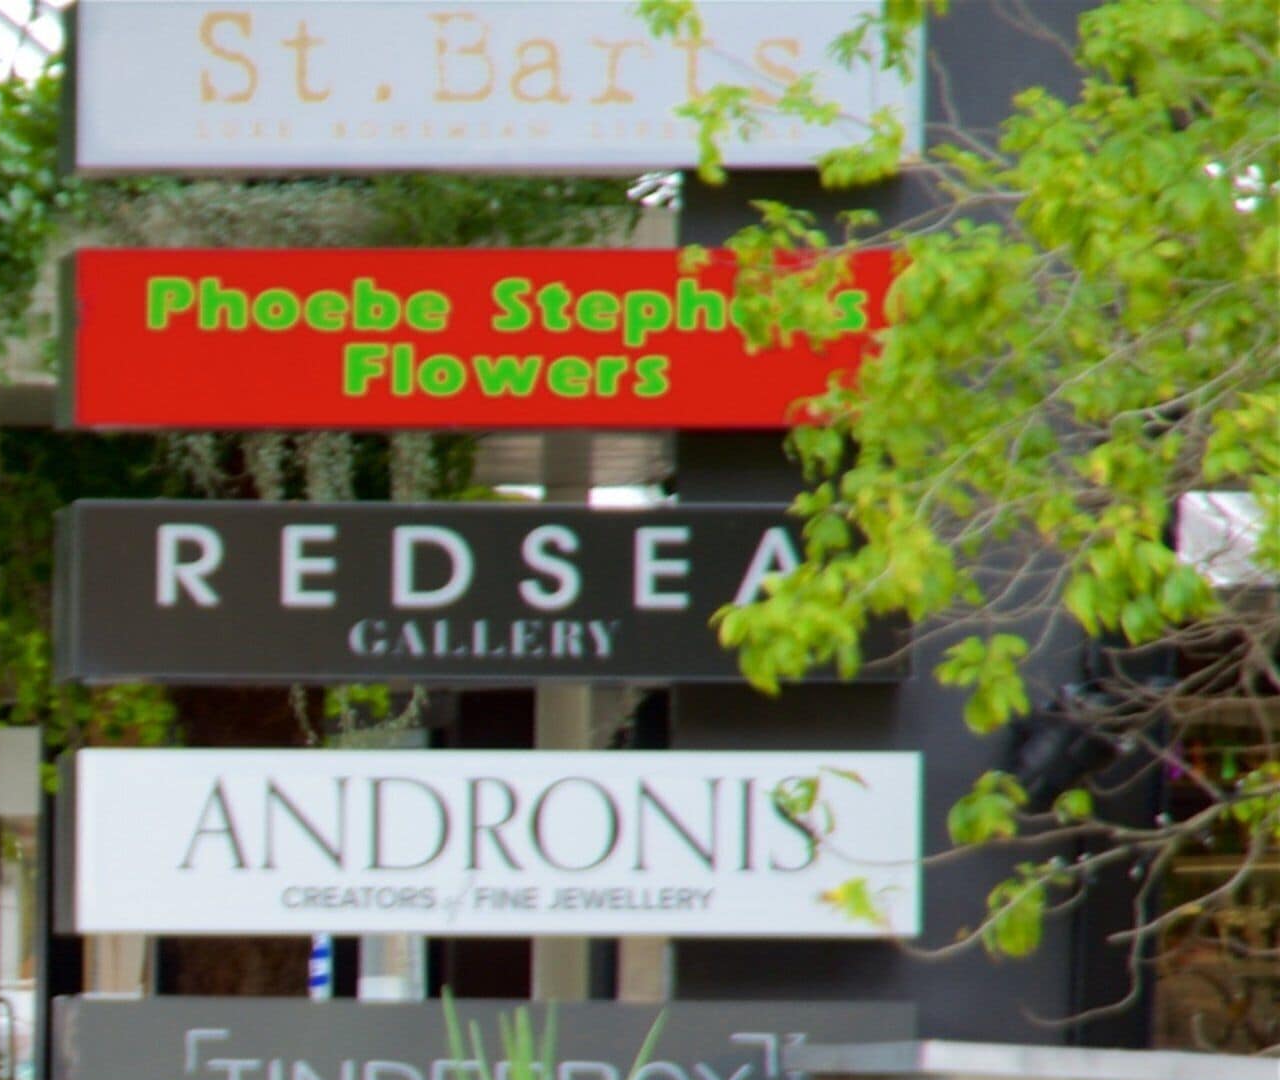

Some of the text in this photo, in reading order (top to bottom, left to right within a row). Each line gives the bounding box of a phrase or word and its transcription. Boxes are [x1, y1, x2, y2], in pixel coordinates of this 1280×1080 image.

[146, 276, 869, 346] Phoebe Stephs
[342, 342, 669, 398] Flowers
[348, 620, 621, 657] GALLERY
[178, 774, 823, 876] ANDRONIS
[281, 885, 438, 910] CREATORS
[473, 885, 540, 910] FINE
[548, 885, 714, 911] JEWELLERY
